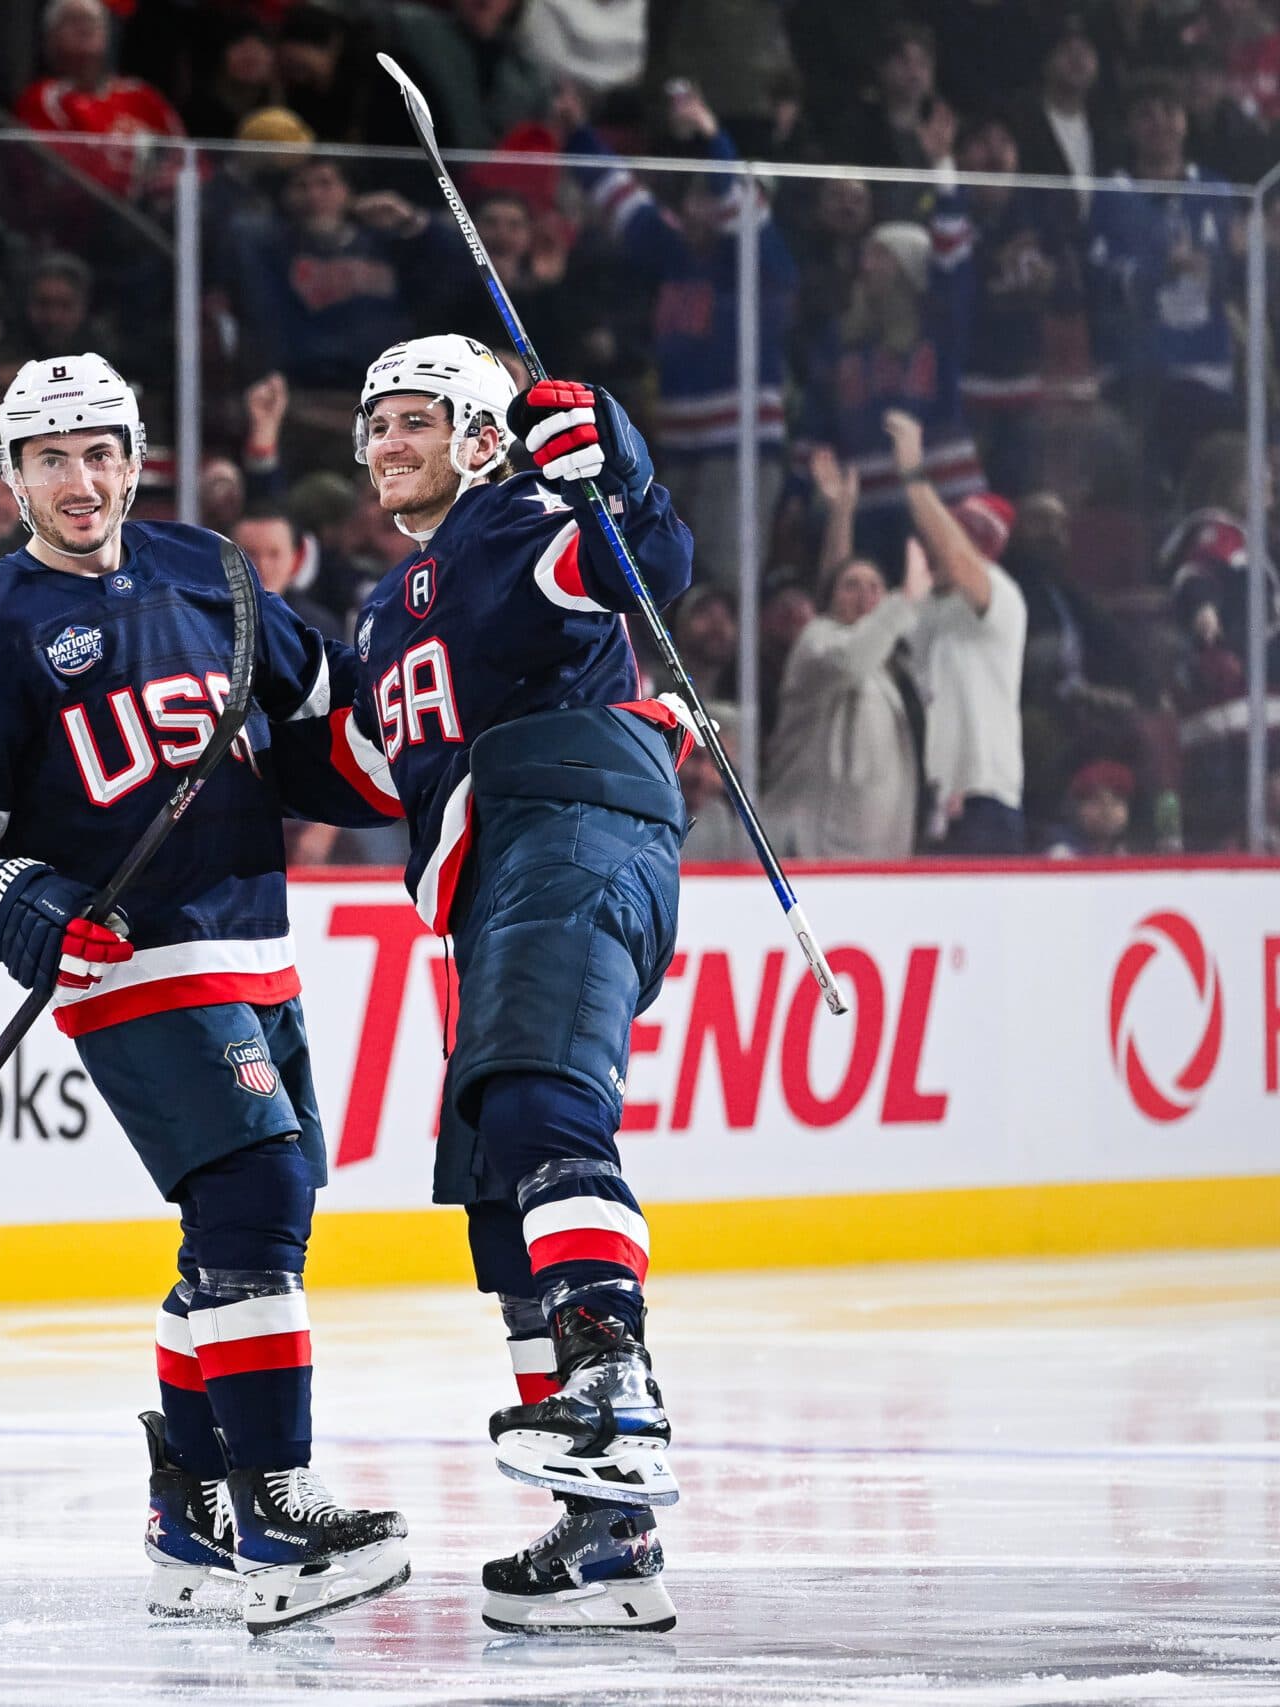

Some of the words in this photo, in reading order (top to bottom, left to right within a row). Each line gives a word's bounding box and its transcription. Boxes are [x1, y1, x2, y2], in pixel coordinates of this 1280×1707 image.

[437, 176, 488, 267] SHERWOOD
[372, 359, 405, 374] CCM
[413, 569, 429, 608] A
[46, 628, 102, 658] NATIONS
[54, 640, 98, 665] FACE-OFF
[372, 635, 465, 764] SA
[232, 1047, 264, 1063] USA
[263, 1528, 309, 1547] BAUER
